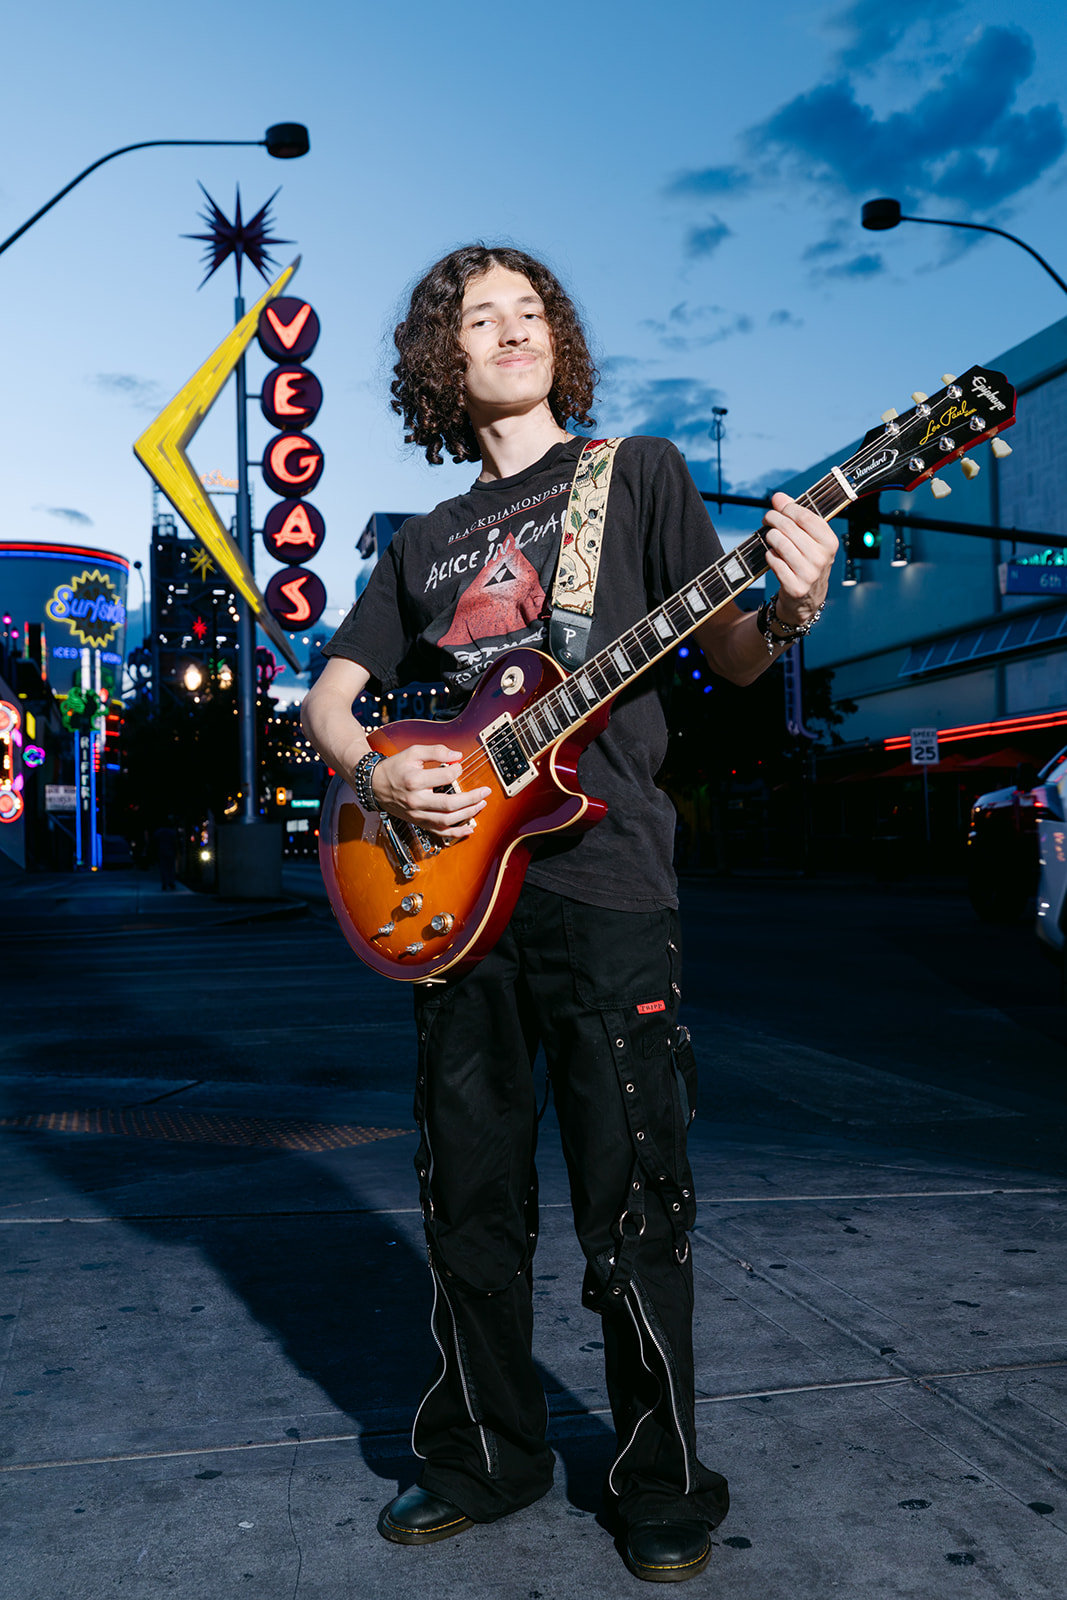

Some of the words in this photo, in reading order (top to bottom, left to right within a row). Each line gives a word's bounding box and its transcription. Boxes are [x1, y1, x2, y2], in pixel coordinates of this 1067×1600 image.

[971, 376, 1006, 411] Epiphone
[919, 419, 941, 445] Les
[940, 400, 968, 427] Paul
[266, 303, 323, 621] VEGAS
[853, 452, 887, 480] Standard
[423, 550, 481, 594] ALICE
[1039, 572, 1062, 588] 6th
[562, 627, 577, 645] P
[914, 746, 937, 760] 25
